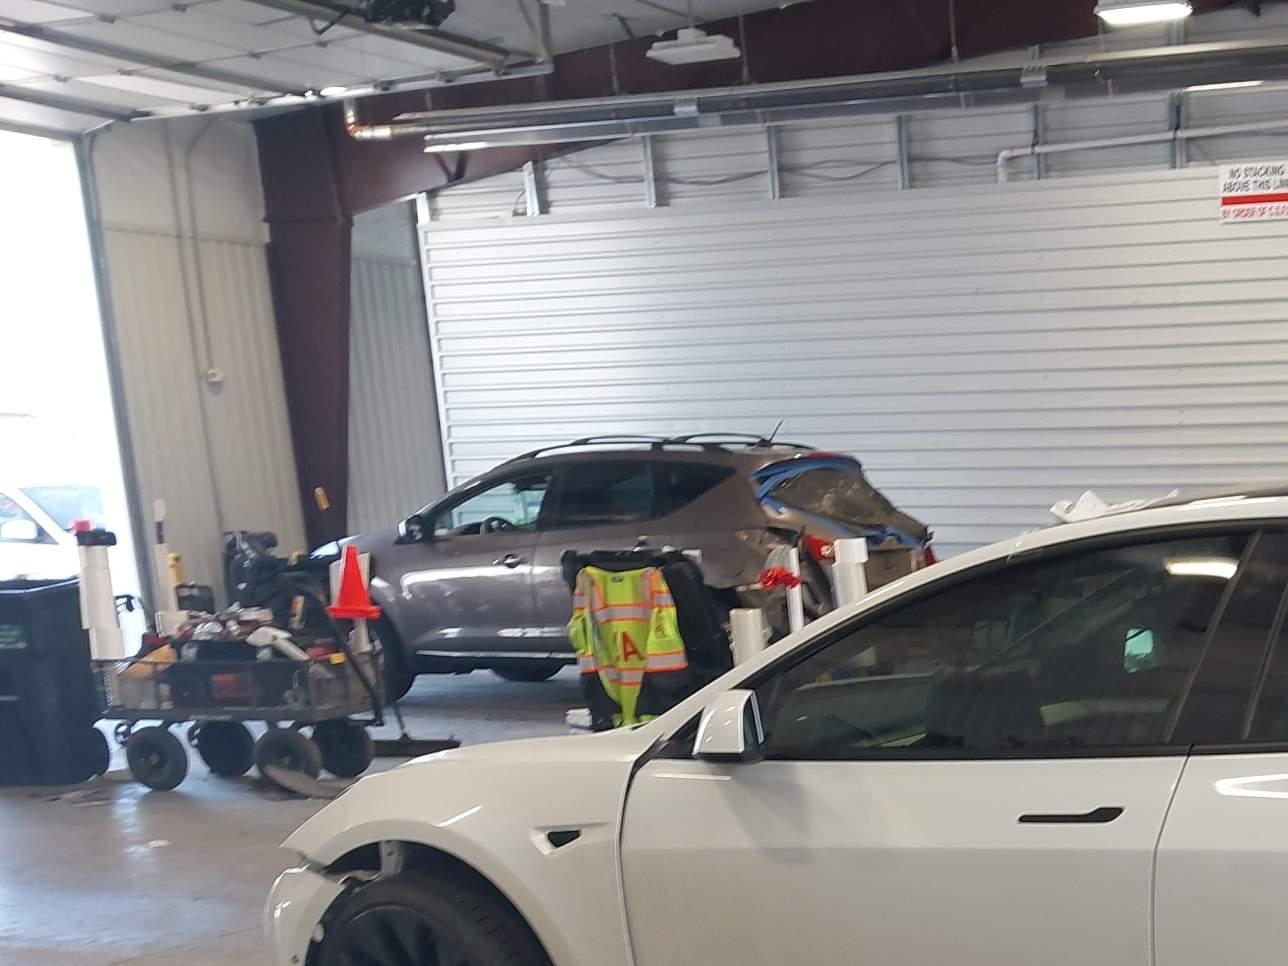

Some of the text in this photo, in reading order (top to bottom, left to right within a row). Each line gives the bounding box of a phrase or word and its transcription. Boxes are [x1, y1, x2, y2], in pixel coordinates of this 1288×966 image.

[1229, 164, 1285, 180] NO STACKING
[1223, 180, 1250, 193] ABOVE
[1252, 179, 1272, 192] THIS
